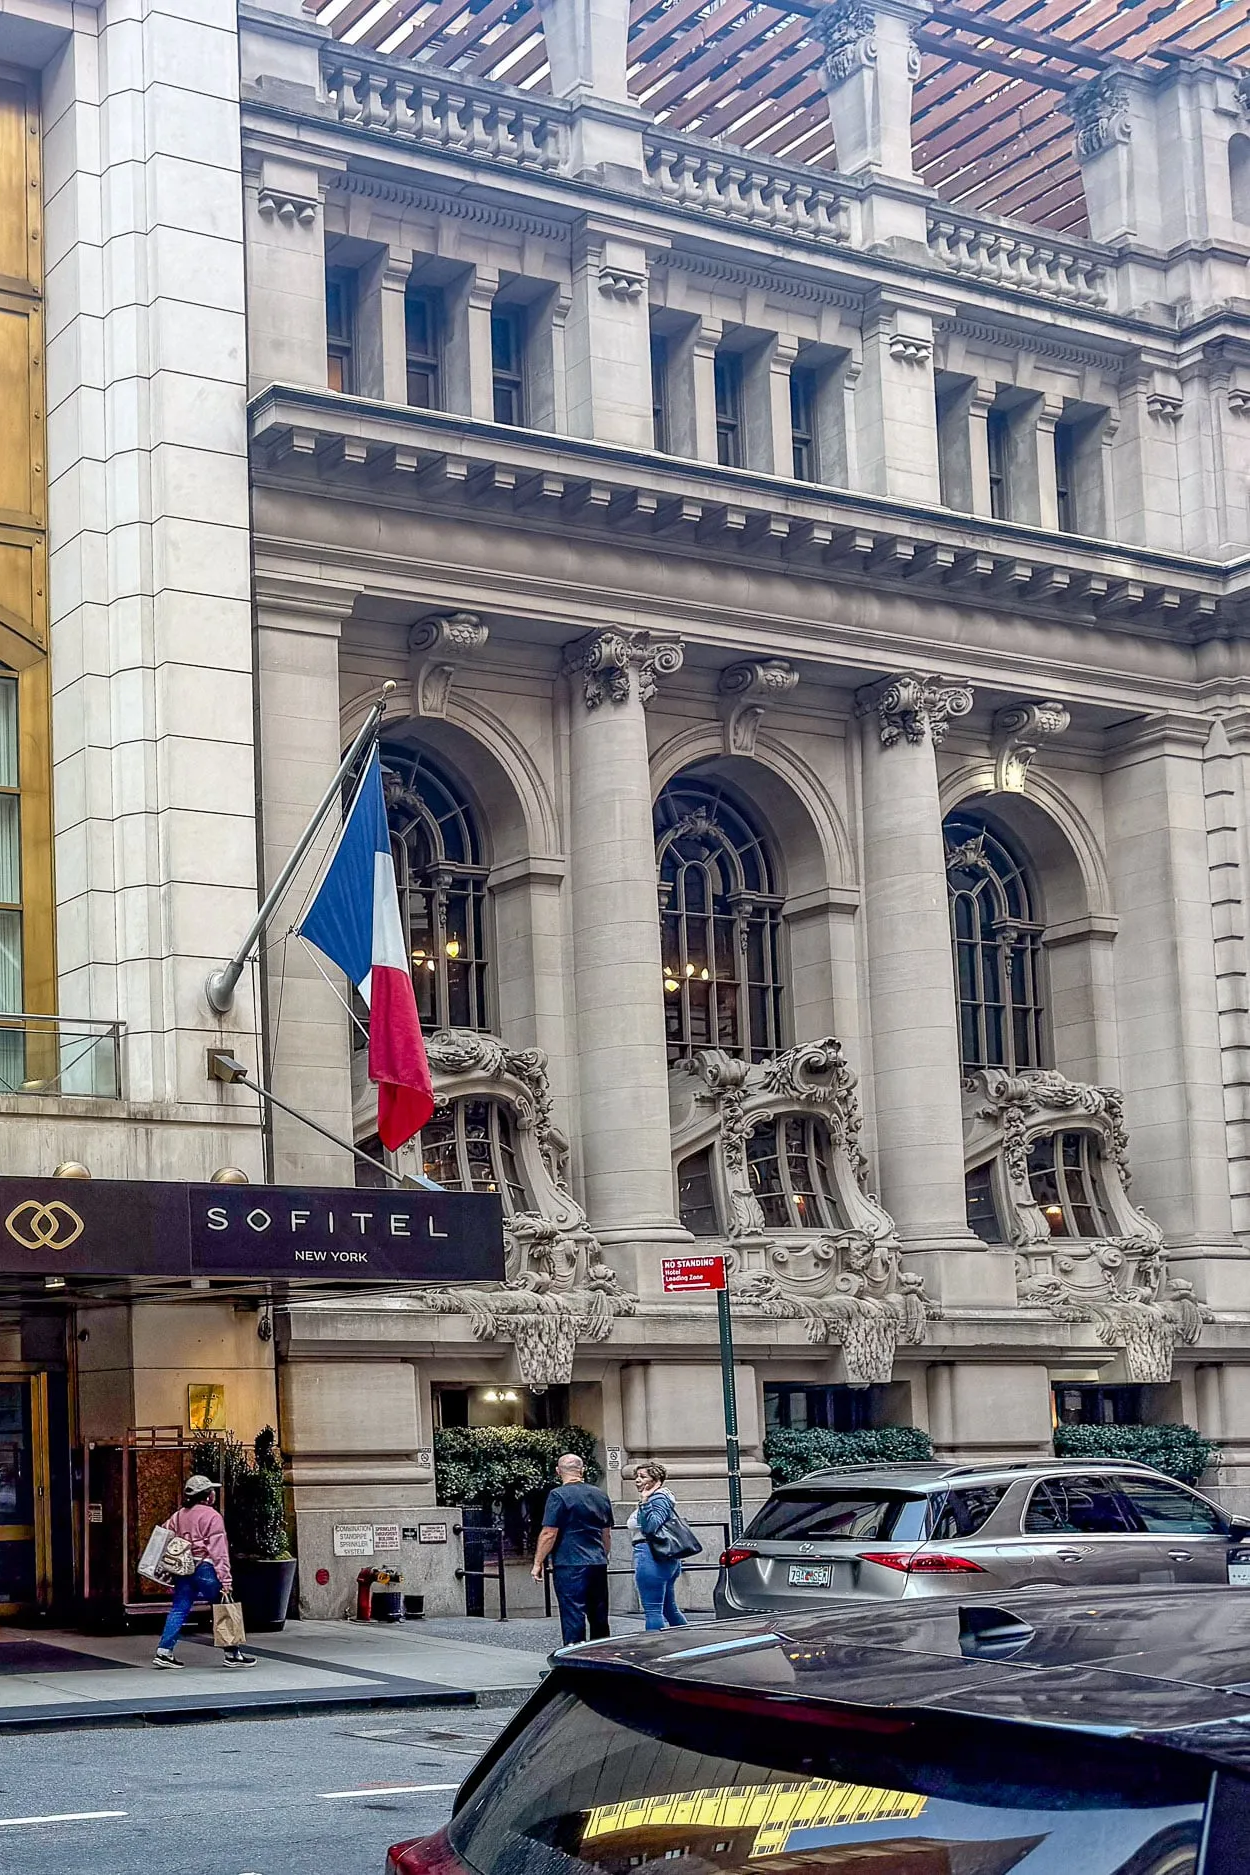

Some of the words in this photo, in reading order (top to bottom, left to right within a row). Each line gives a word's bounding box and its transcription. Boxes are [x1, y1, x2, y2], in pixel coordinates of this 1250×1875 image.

[206, 1207, 449, 1238] SOFITEL
[294, 1250, 327, 1262] NEW
[330, 1251, 368, 1263] YORK
[664, 1261, 676, 1269] NO
[676, 1258, 715, 1268] STANDING
